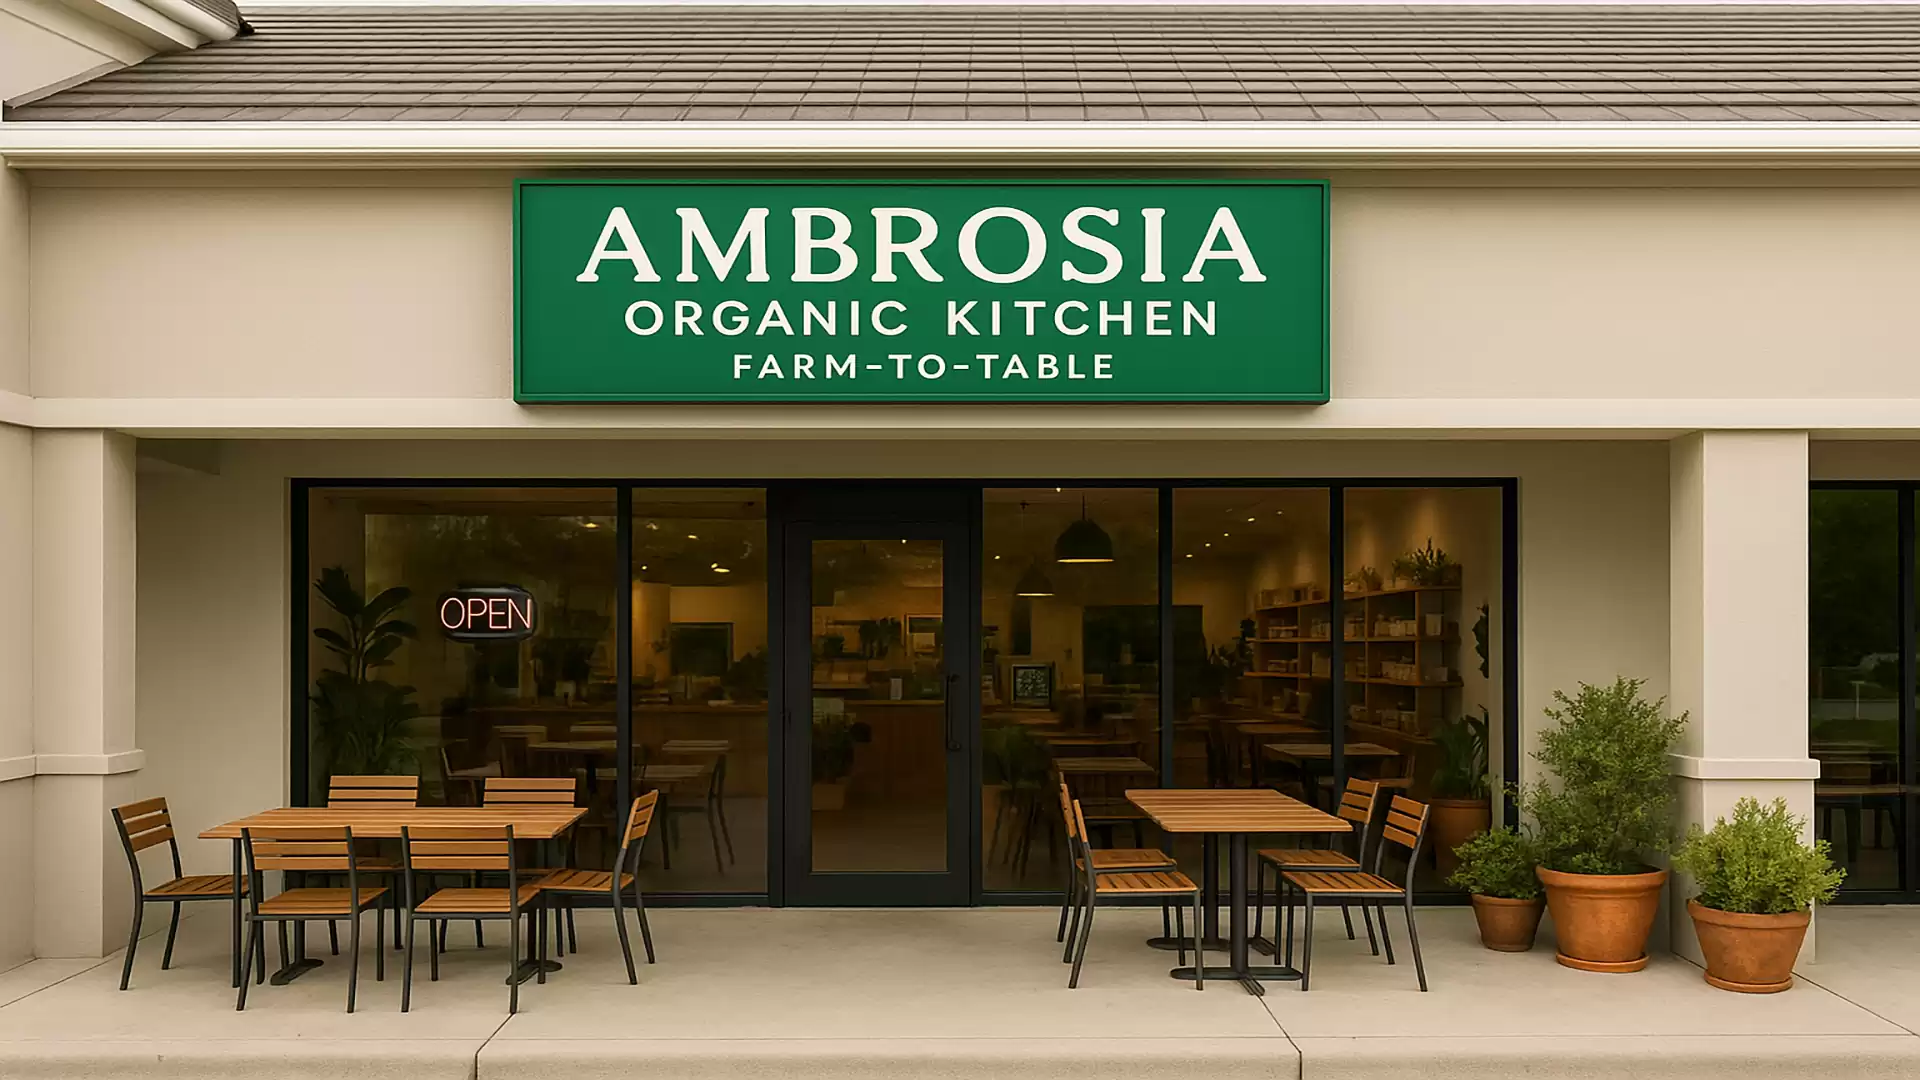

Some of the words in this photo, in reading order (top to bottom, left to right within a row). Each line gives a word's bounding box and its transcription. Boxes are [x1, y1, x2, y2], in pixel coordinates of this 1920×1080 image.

[576, 207, 1266, 283] AMBROSIA
[625, 300, 908, 336] ORGANIC
[947, 300, 1216, 336] KITCHEN
[733, 353, 1113, 379] FARM-TO-TABLE
[441, 597, 532, 629] OPEN
